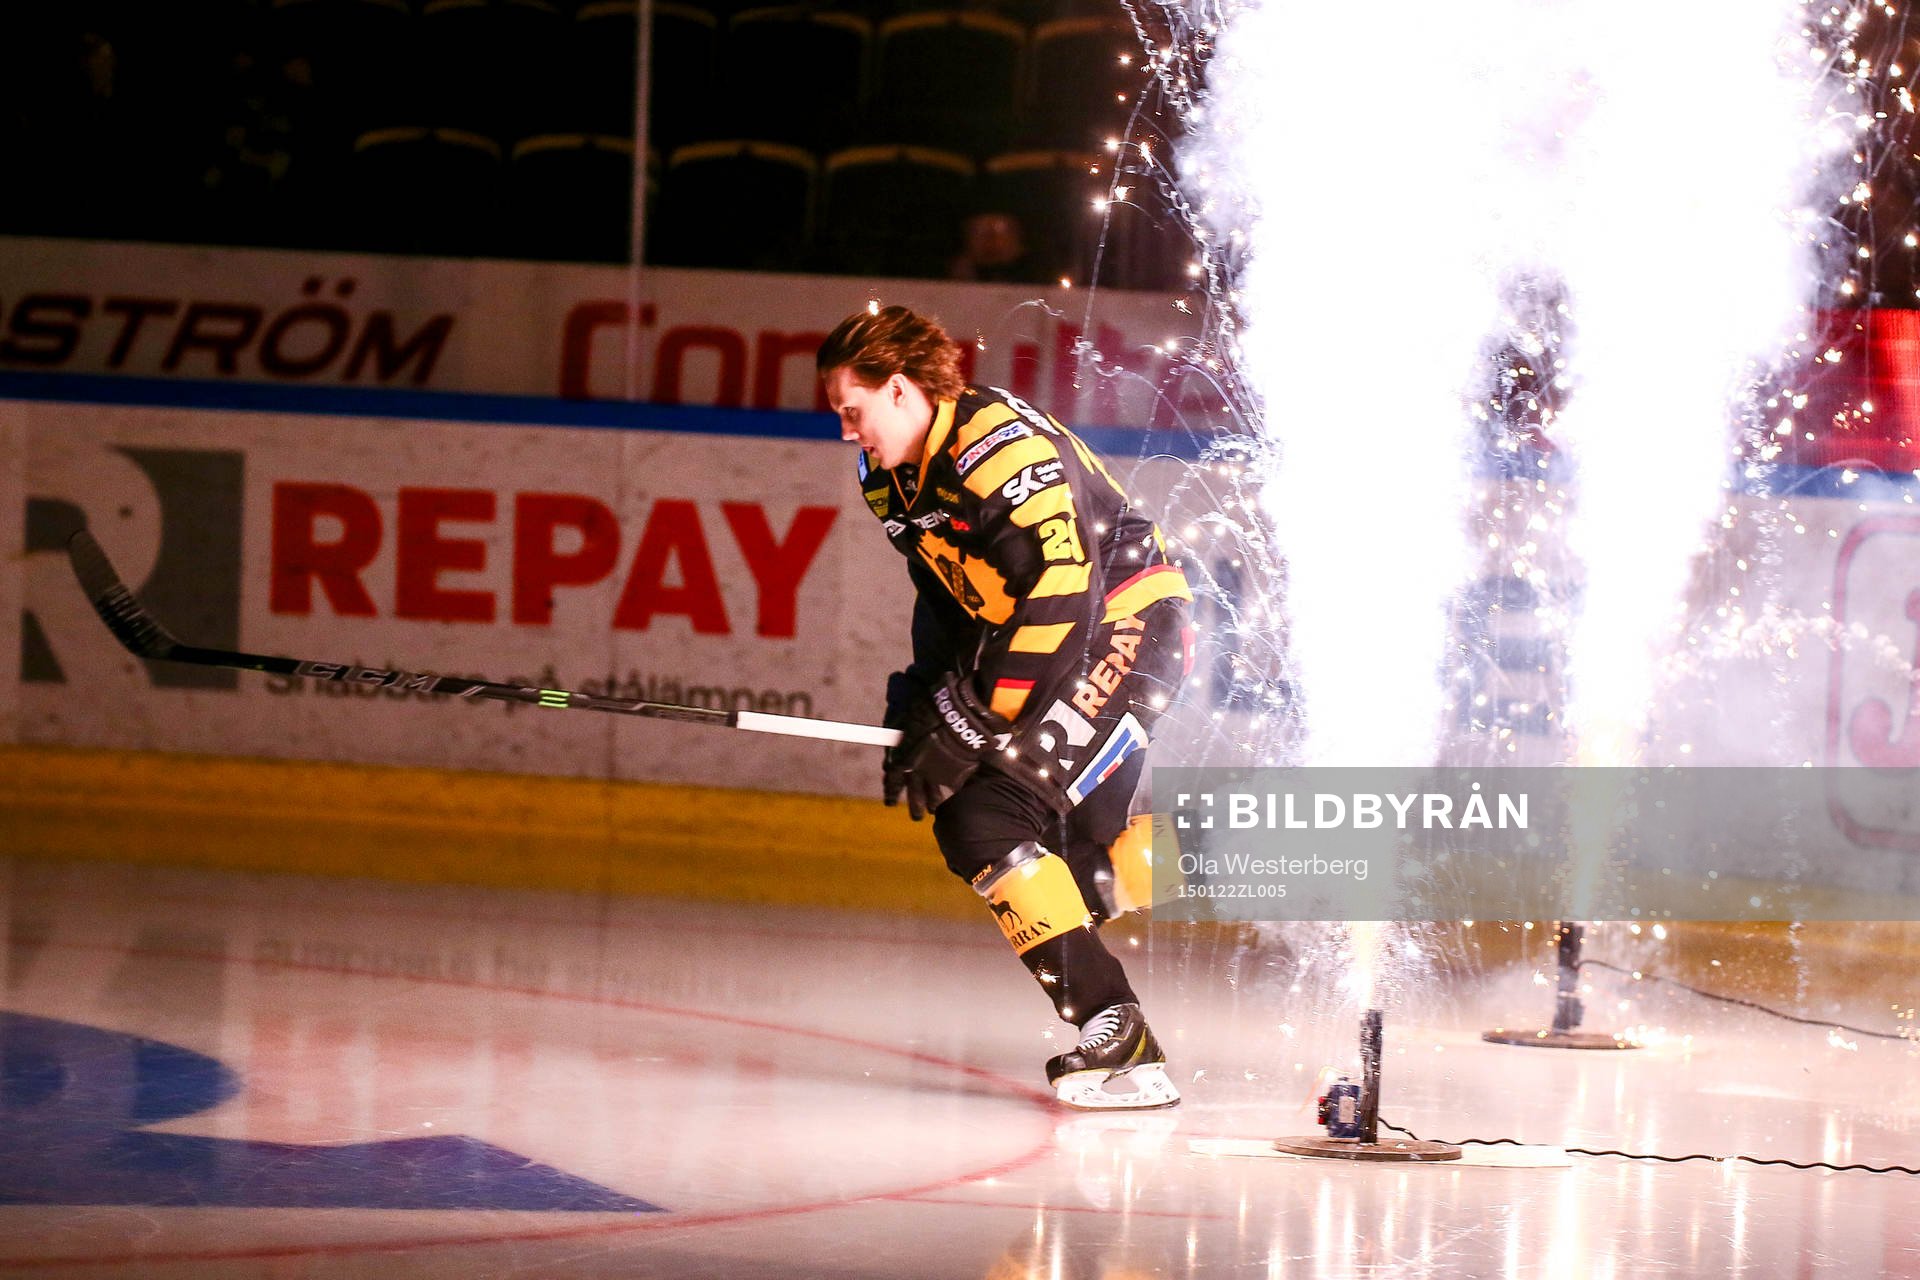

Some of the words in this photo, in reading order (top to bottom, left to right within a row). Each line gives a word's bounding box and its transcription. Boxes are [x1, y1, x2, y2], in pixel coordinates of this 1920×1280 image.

[0, 276, 456, 384] STRÖM
[270, 482, 840, 638] REPAY
[1038, 518, 1086, 562] 21
[294, 661, 442, 693] CCM
[1072, 614, 1146, 719] REPAY
[933, 687, 988, 750] Reebok
